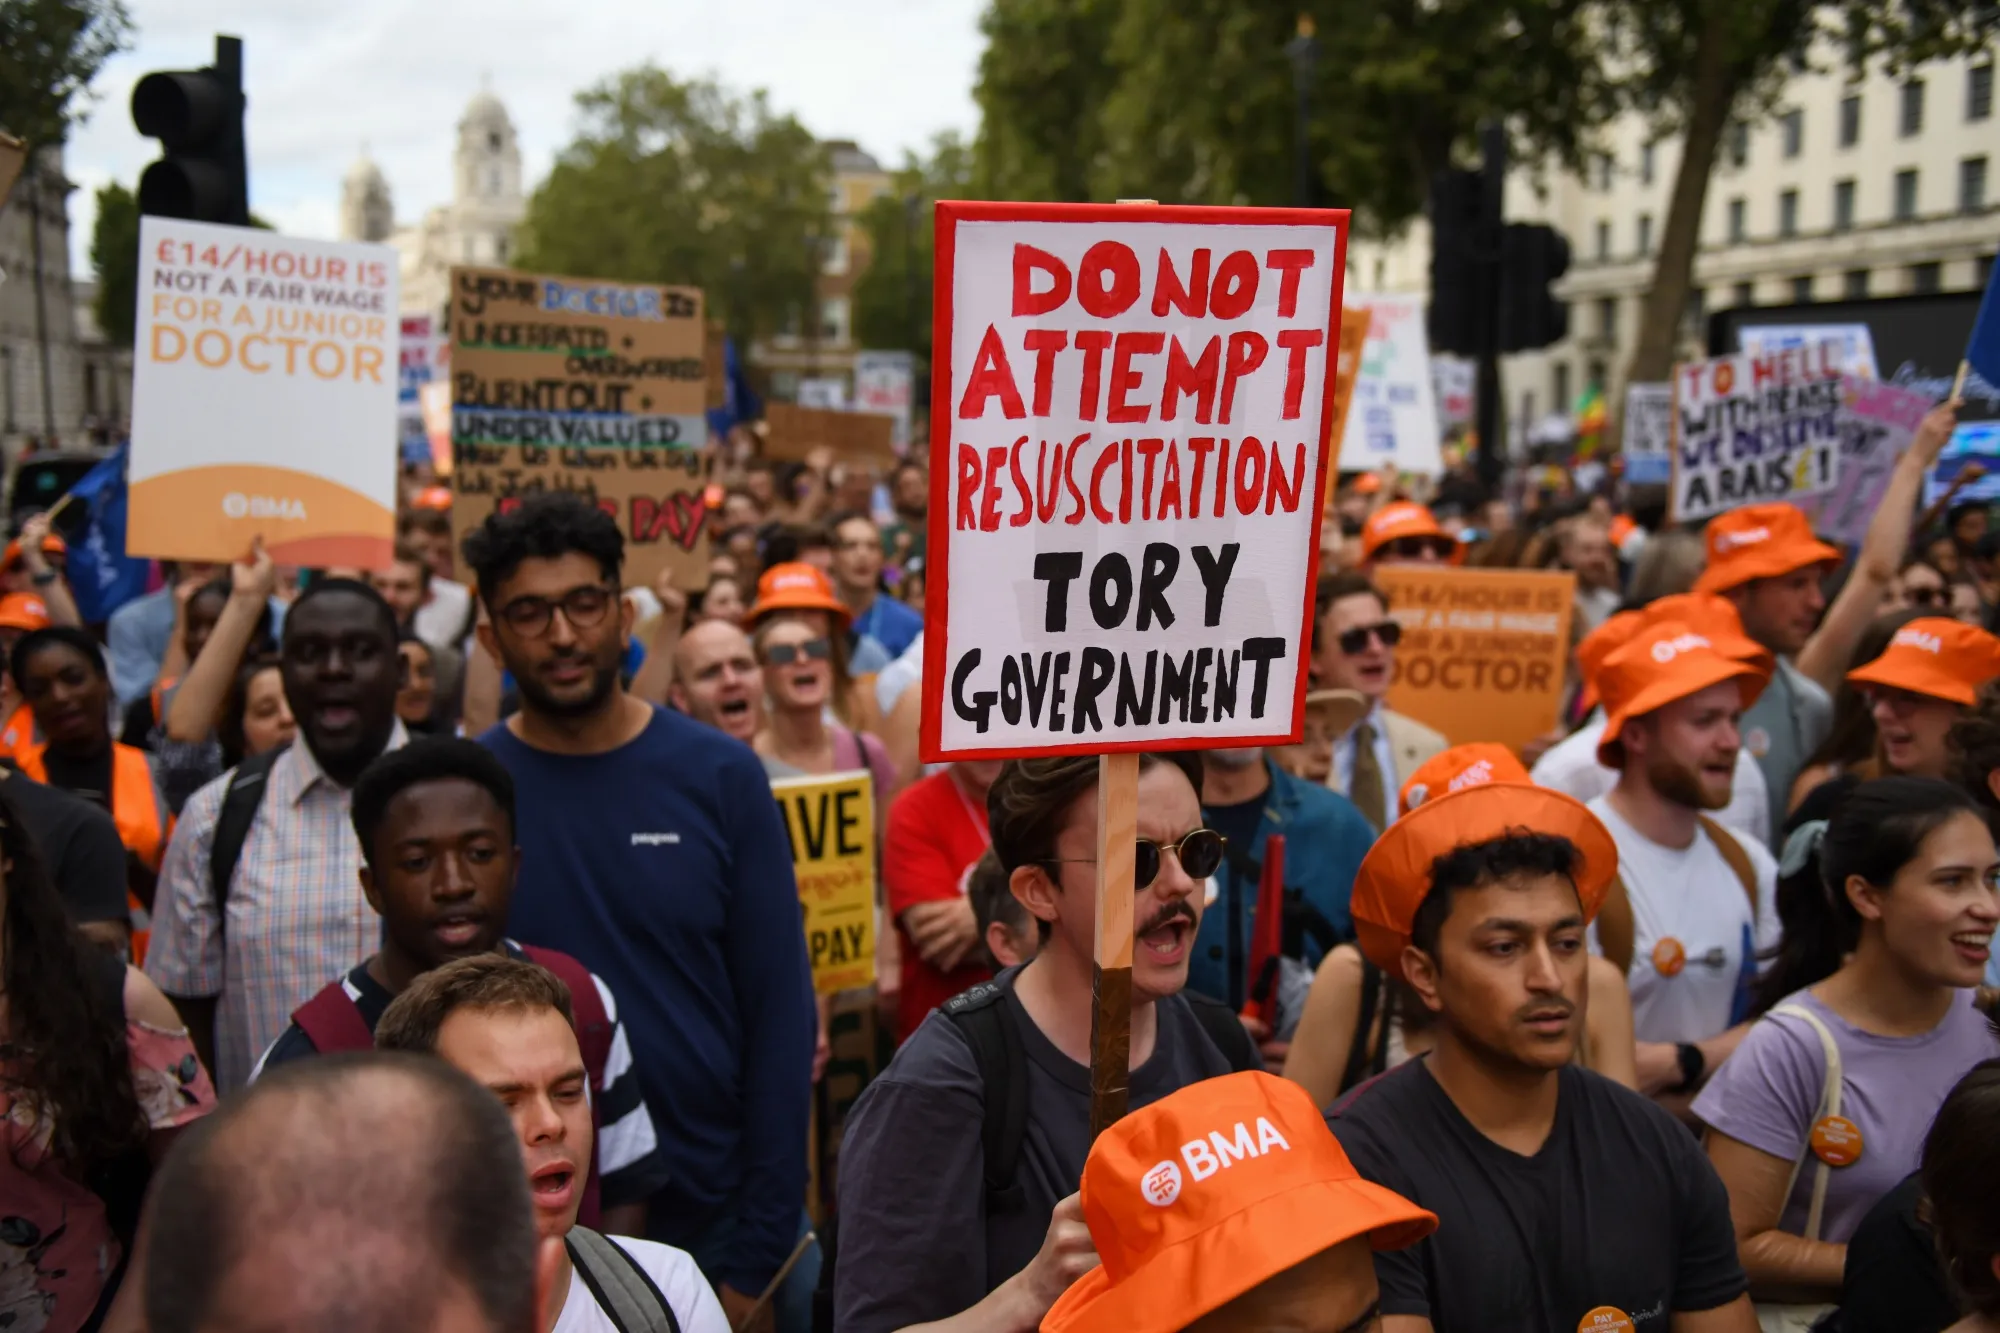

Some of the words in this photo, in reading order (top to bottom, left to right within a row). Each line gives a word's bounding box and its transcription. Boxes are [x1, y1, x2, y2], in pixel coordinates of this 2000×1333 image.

[153, 269, 211, 296] NOT
[219, 277, 238, 298] A
[245, 279, 305, 306] FAIR
[311, 286, 387, 315] WAGE
[156, 239, 347, 284] £14/HOUR
[357, 262, 387, 289] IS
[1011, 240, 1141, 319] DO
[1151, 246, 1315, 320] NOT
[152, 294, 222, 326] FOR
[231, 303, 257, 327] A
[261, 307, 386, 342] JUNIOR
[541, 279, 666, 323] DOCTOR
[151, 322, 386, 385] DOCTOR
[958, 322, 1323, 425] ATTEMPT
[956, 432, 1306, 532] RESUSCITATION
[630, 491, 708, 549] PAY
[1033, 542, 1240, 632] TORY
[951, 637, 1286, 734] GOVERNMENT
[810, 923, 866, 971] PAY
[1179, 1116, 1292, 1183] BMA
[1593, 1312, 1613, 1324] PAY
